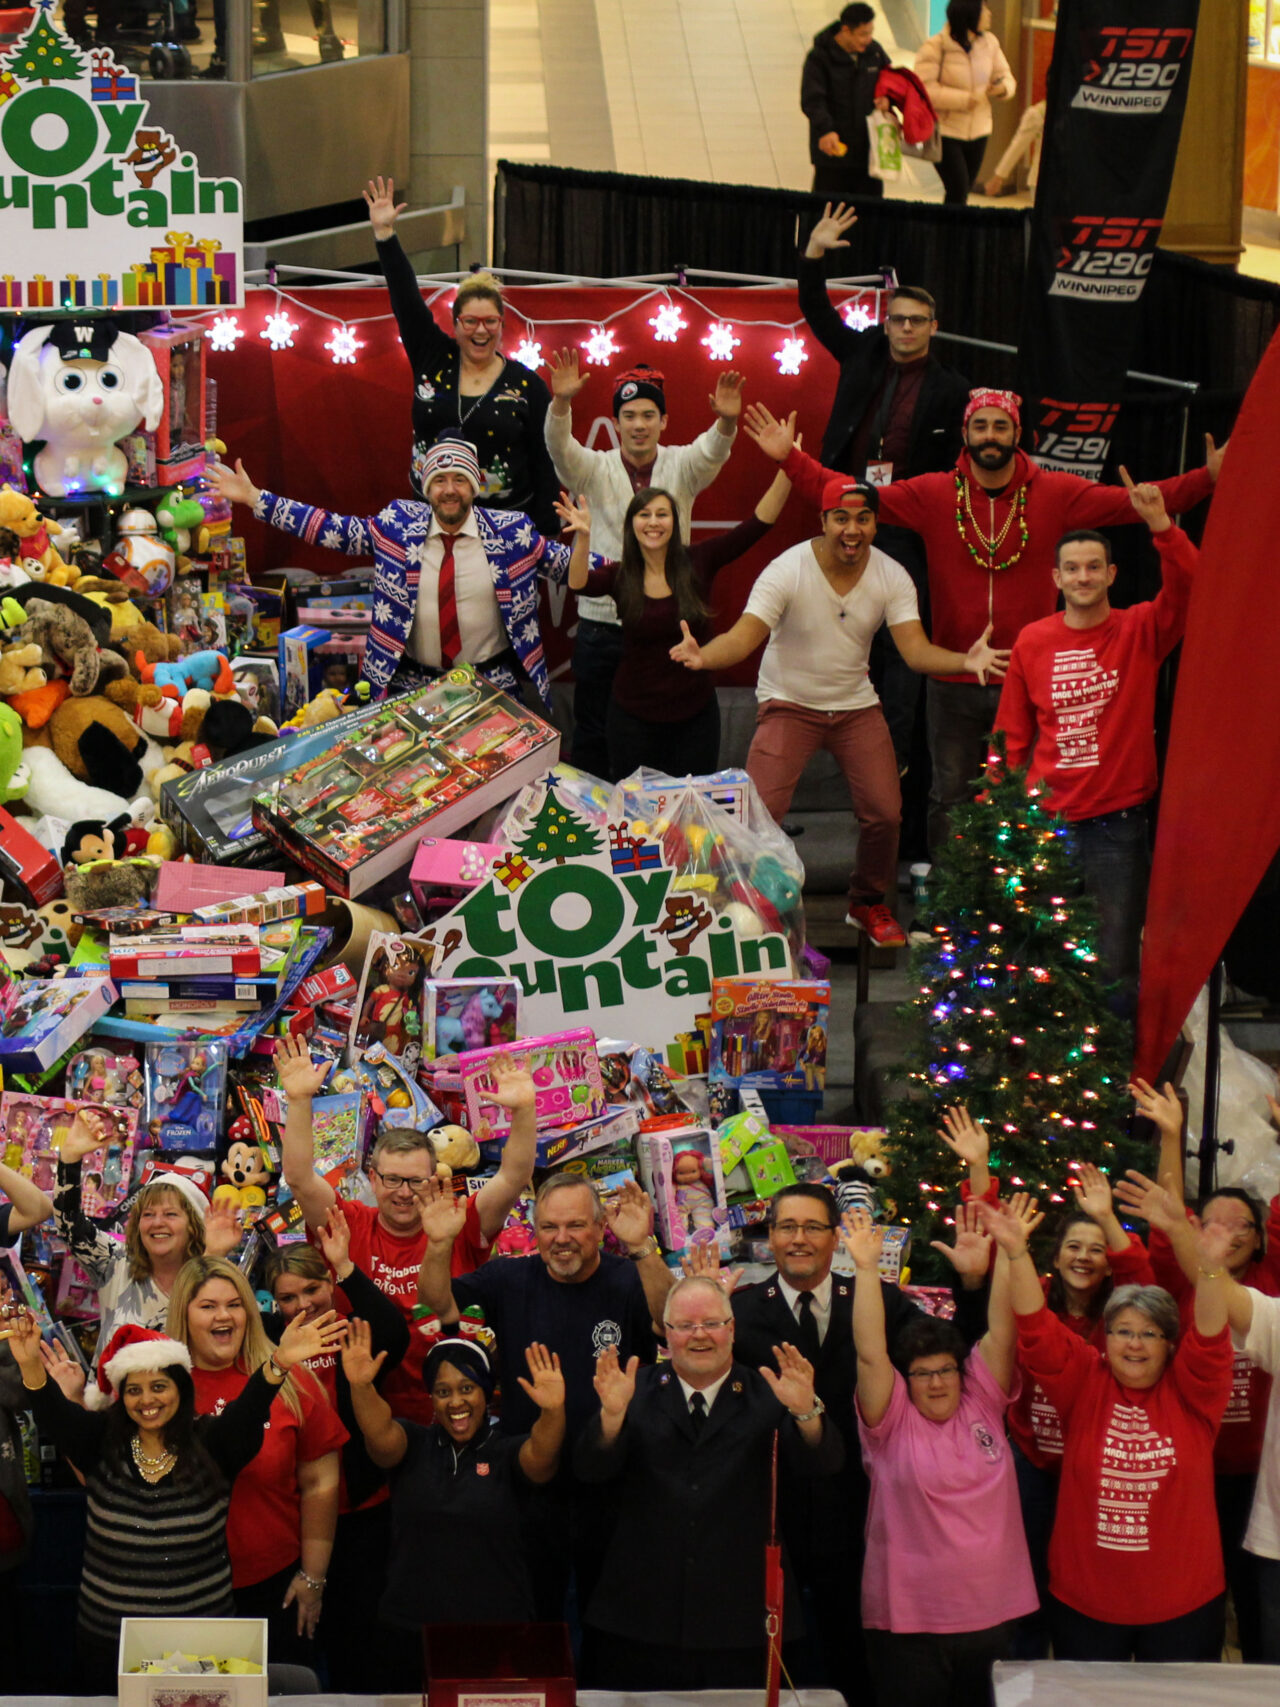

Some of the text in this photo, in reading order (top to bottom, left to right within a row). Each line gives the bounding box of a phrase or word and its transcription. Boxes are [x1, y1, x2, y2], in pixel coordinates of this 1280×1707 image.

[1100, 26, 1194, 59] TSN
[1100, 62, 1181, 87] 1290
[1082, 91, 1163, 108] WINNIPEG
[1057, 279, 1137, 296] WINNIPEG
[74, 327, 95, 343] W
[1039, 432, 1111, 460] 129
[166, 1128, 192, 1136] FROZEN
[547, 1138, 567, 1159] NERF
